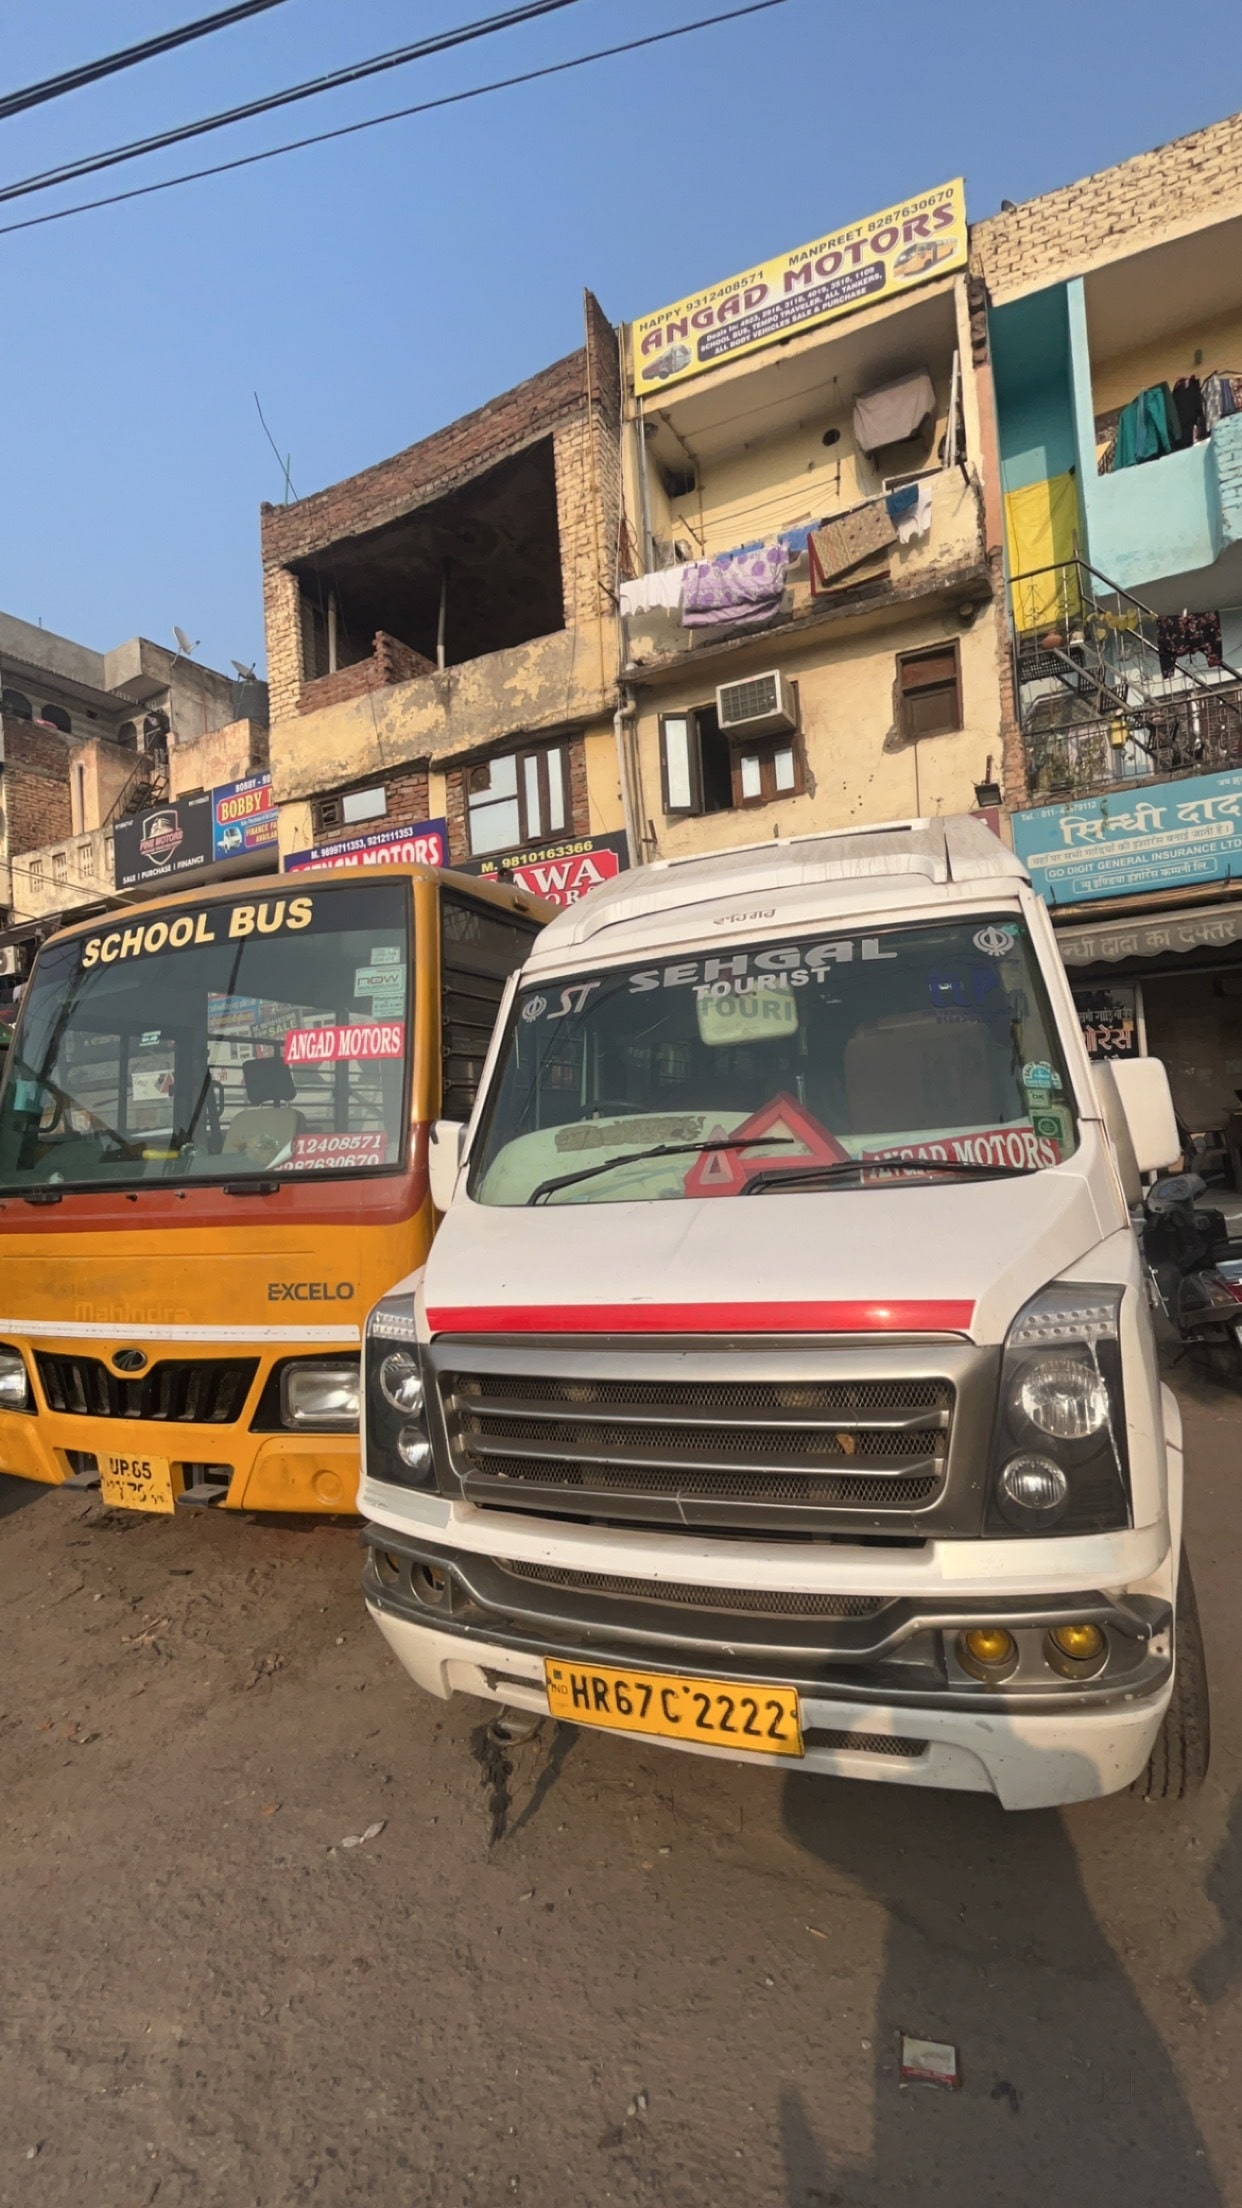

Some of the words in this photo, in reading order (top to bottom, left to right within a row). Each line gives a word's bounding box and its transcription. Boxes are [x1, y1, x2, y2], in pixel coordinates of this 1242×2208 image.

[640, 307, 681, 332] HAPPY
[686, 271, 763, 311] 9312408571
[789, 227, 863, 266] MANPREET
[868, 188, 954, 232] 8287630670
[641, 283, 768, 355] ANGAD
[783, 202, 954, 293] MOTORS
[700, 337, 730, 352] SCHOOL
[752, 313, 778, 329] TEMPO
[824, 289, 840, 300] ALL
[706, 329, 727, 341] Deals
[714, 344, 729, 355] ALL
[730, 335, 751, 347] BODY
[752, 319, 791, 339] VEHICLES
[791, 308, 812, 322] SALE
[822, 286, 867, 310] PURCHASE
[221, 791, 262, 821] BOBBY
[1059, 802, 1167, 845] सिन्धी
[122, 874, 136, 884] SALE
[141, 865, 171, 879] PURCHASE
[177, 855, 204, 869] FINANCE
[481, 861, 498, 873] M.
[502, 840, 593, 868] 9810163366
[1048, 868, 1065, 878] GO
[1067, 863, 1094, 875] DIGIT
[1097, 854, 1149, 870] GENERAL
[1151, 842, 1217, 861] INSURANCE
[82, 911, 215, 968] SCHOOL
[228, 897, 313, 940] BUS
[1101, 933, 1139, 956] दादा
[1145, 927, 1171, 946] का
[1177, 919, 1237, 944] दफ्तर
[629, 938, 898, 993] SEHGAL
[692, 965, 831, 1000] TOURIST
[547, 981, 601, 1019] ST
[287, 1031, 334, 1062] ANGAD
[338, 1025, 401, 1058] MOTORS
[952, 1132, 1057, 1169] MOTORS
[267, 1282, 355, 1301] EXCELO
[75, 1302, 192, 1323] Mahindra
